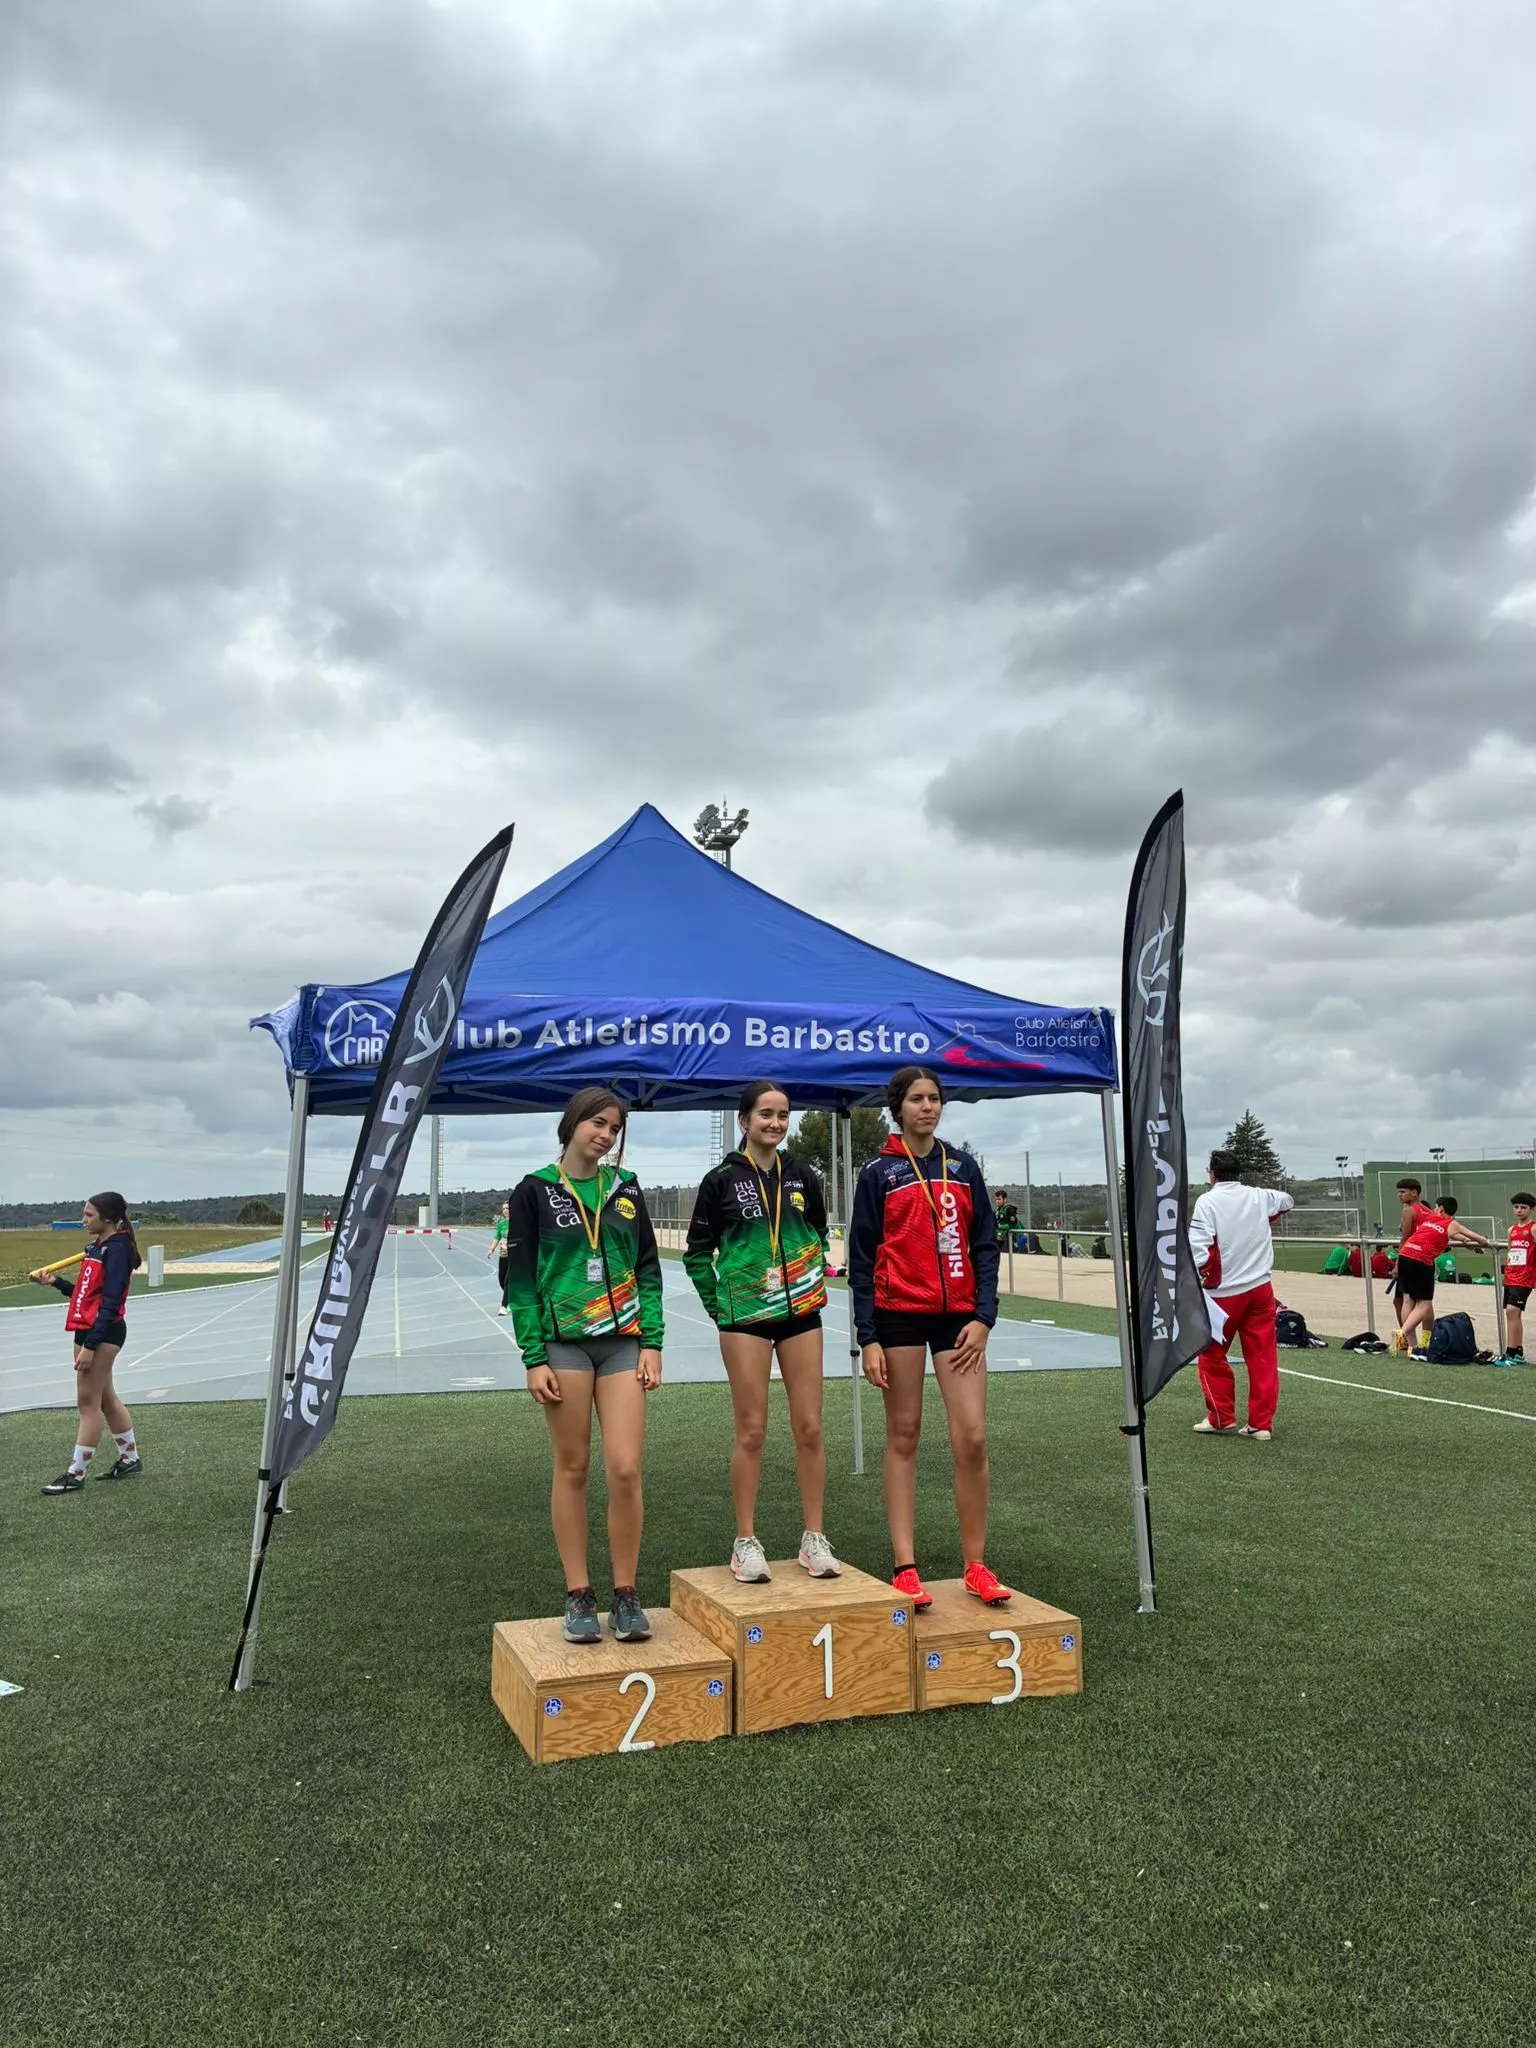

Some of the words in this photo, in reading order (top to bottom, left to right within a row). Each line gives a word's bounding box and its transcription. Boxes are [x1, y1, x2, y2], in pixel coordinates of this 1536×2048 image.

[1014, 1016, 1045, 1029] Club
[1048, 1016, 1100, 1030] Atletismo
[451, 1017, 521, 1050] lub
[534, 1014, 731, 1049] Atletismo
[745, 1017, 930, 1055] Barbastro
[1015, 1031, 1101, 1048] Barbastro
[343, 1036, 385, 1067] CAB
[544, 1185, 558, 1196] H
[737, 1188, 759, 1203] es
[549, 1194, 573, 1209] es
[556, 1212, 582, 1228] ca
[742, 1204, 763, 1220] ca
[812, 1623, 834, 1699] 1
[988, 1629, 1023, 1705] 3
[618, 1671, 656, 1753] 2
